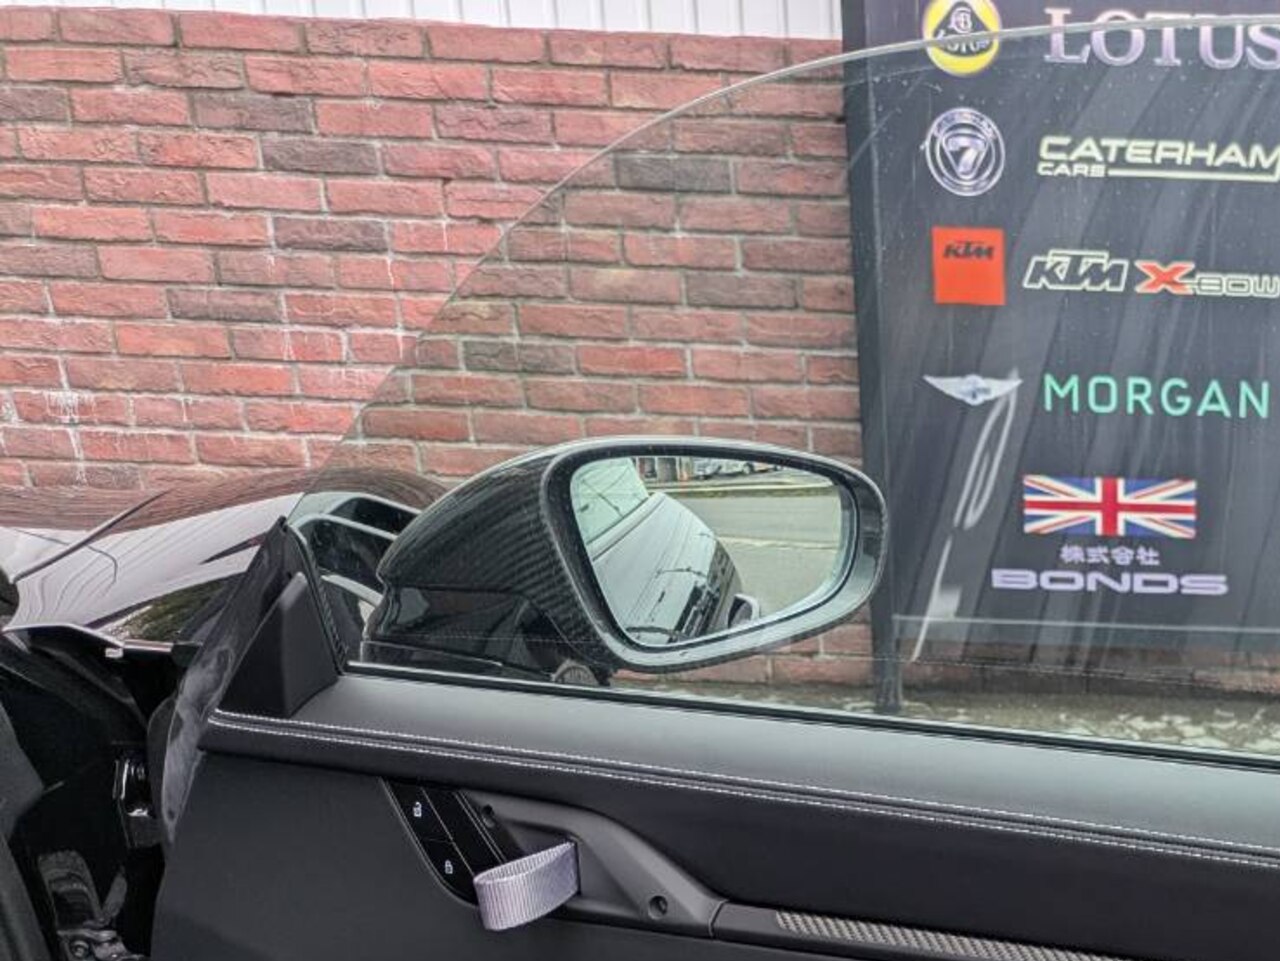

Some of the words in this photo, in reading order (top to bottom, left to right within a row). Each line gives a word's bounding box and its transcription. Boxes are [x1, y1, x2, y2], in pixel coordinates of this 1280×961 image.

[1036, 160, 1107, 178] CARS
[1022, 249, 1130, 292] KTM
[1043, 373, 1271, 419] MORGAN
[1059, 544, 1161, 566] 株式会社
[991, 568, 1230, 596] BONDS
